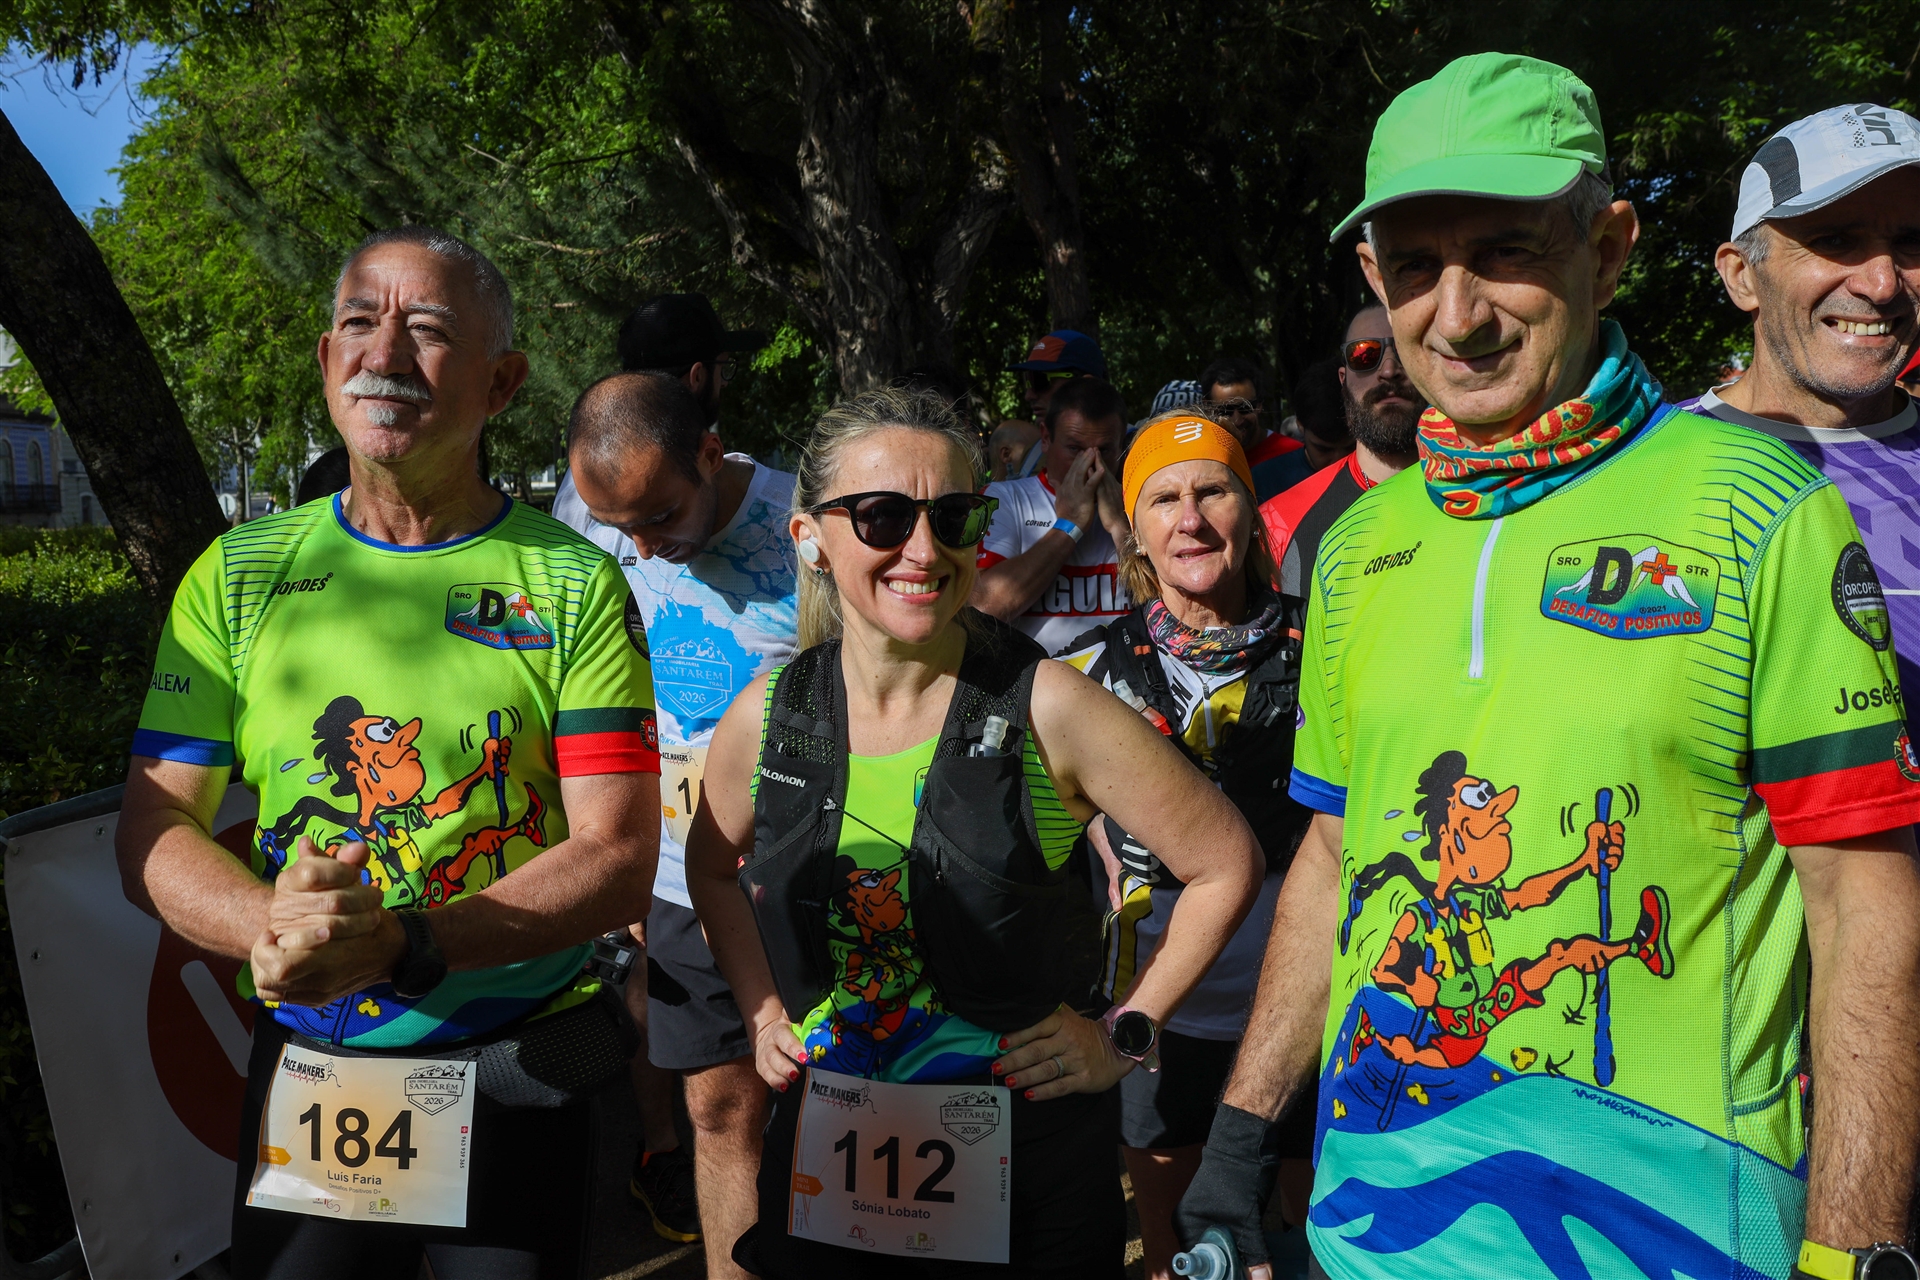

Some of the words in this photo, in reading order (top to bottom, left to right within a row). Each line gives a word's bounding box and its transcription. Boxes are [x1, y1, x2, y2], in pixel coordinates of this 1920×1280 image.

[1557, 557, 1581, 566] SRO
[1685, 565, 1709, 576] STR
[1030, 573, 1132, 613] GUIA
[1550, 598, 1618, 629] DESAFIOS
[1624, 611, 1702, 631] POSITIVOS
[452, 620, 500, 643] DESAFIOS
[655, 665, 723, 681] SANTARÉM
[679, 690, 706, 704] 2026
[760, 765, 806, 788] ALOMON
[1449, 983, 1515, 1036] SRO
[409, 1083, 458, 1091] SANTARÉM
[424, 1097, 444, 1105] 2026
[945, 1110, 994, 1119] SANTARÉM
[300, 1103, 417, 1170] 184
[961, 1126, 981, 1134] 2026
[834, 1129, 956, 1204] 112
[353, 1174, 382, 1185] Faria
[329, 1183, 348, 1192] Desafios
[796, 1183, 810, 1191] TRAIL
[852, 1200, 884, 1214] Sónia
[888, 1205, 931, 1219] Lobato
